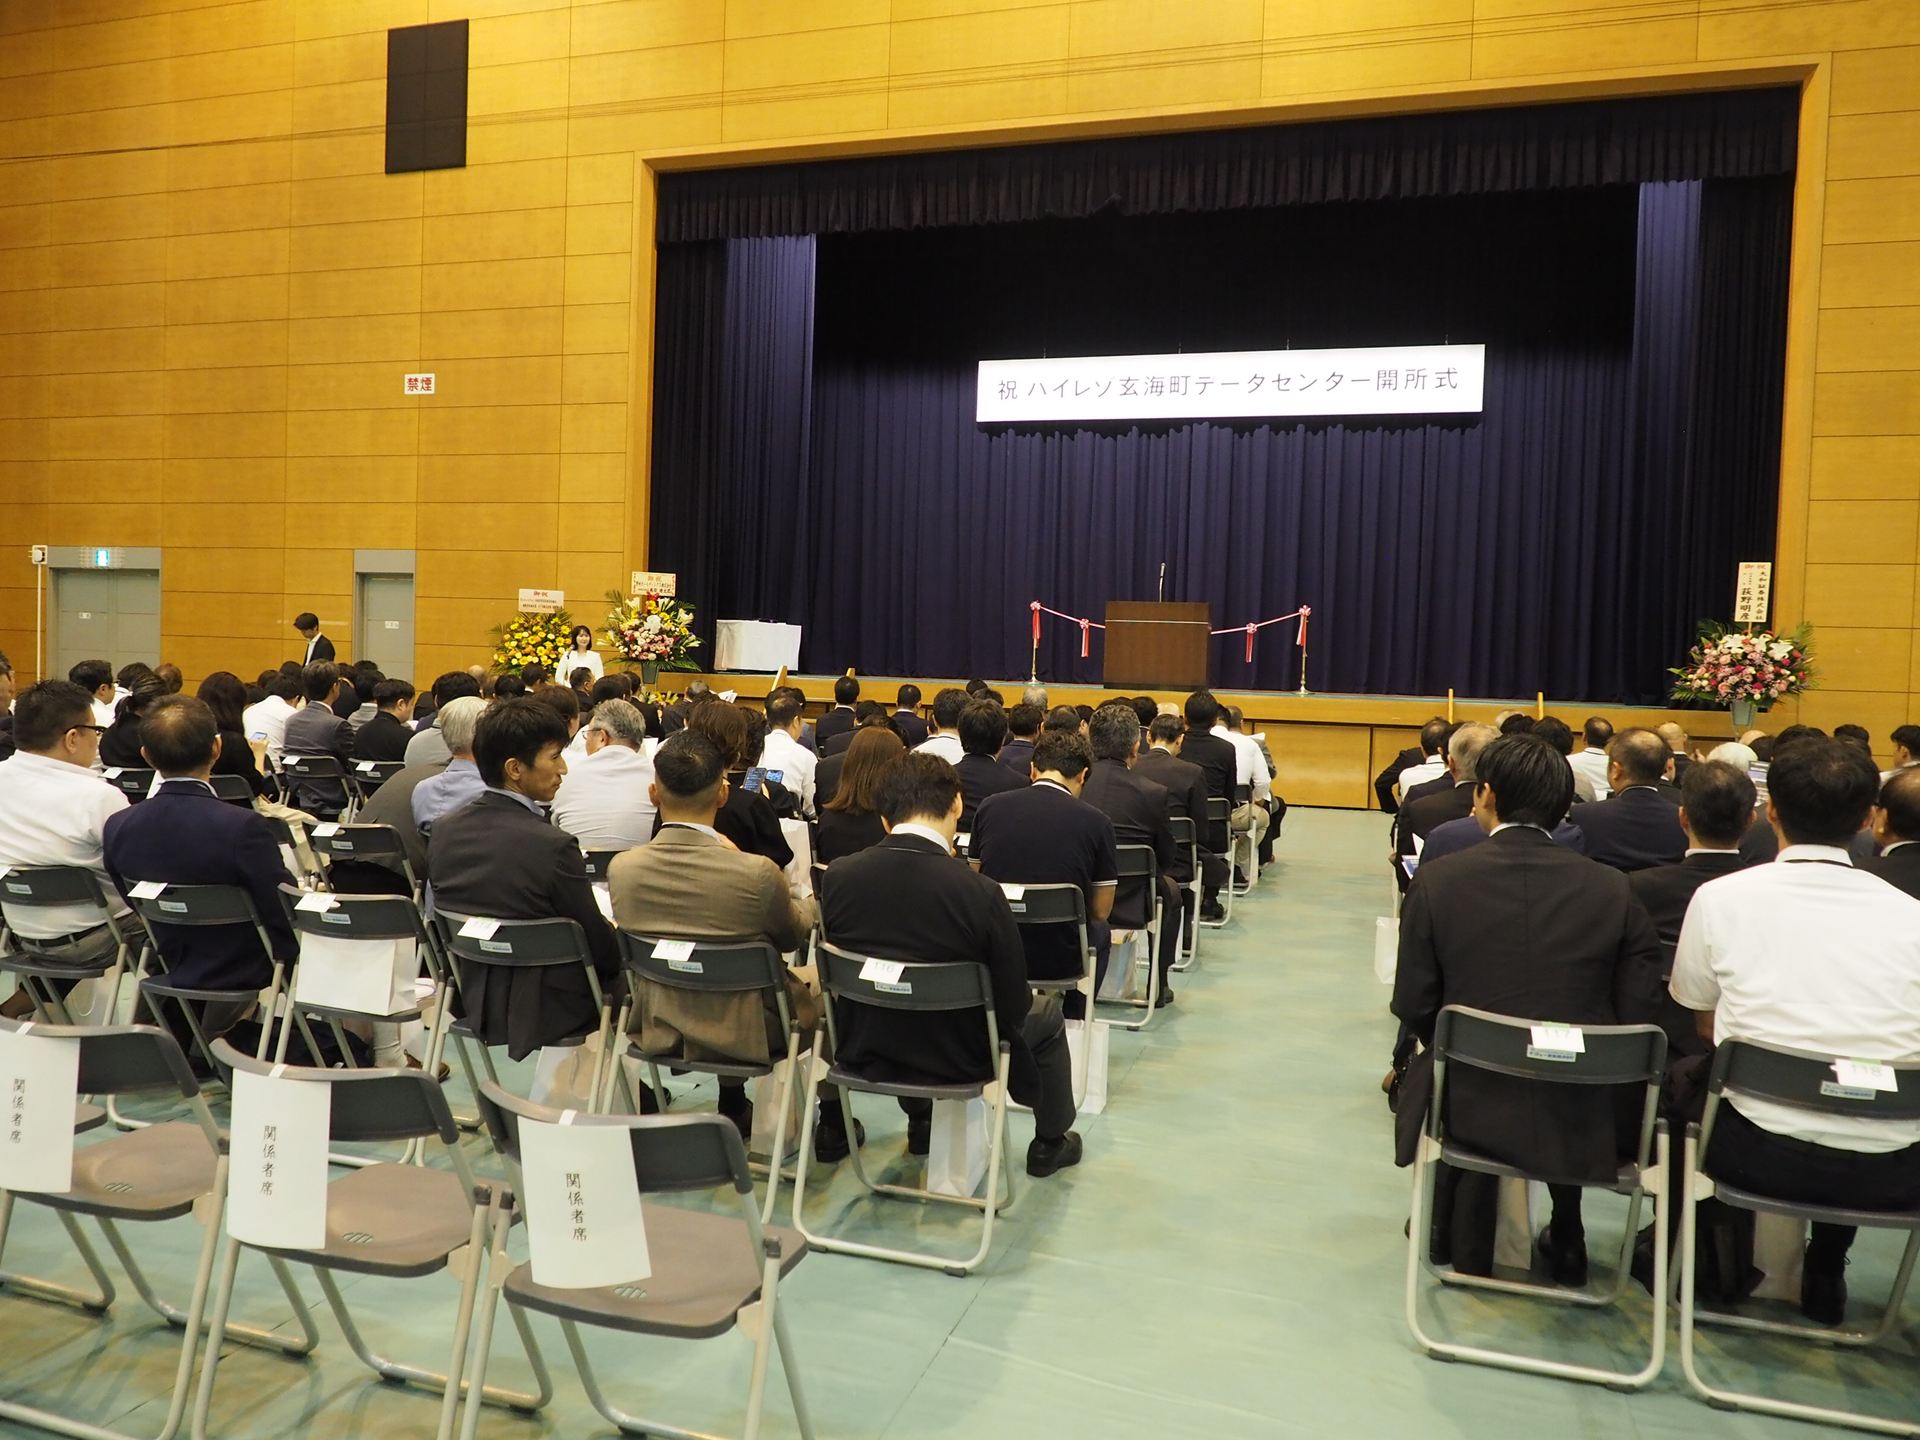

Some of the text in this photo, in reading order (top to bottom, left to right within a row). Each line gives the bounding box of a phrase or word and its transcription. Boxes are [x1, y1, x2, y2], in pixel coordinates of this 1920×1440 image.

[407, 376, 433, 391] 禁煙
[998, 380, 1018, 400] 祝
[9, 1078, 26, 1144] 関係者席
[260, 1125, 277, 1196] 関係者席
[565, 1172, 588, 1242] 関係者席
